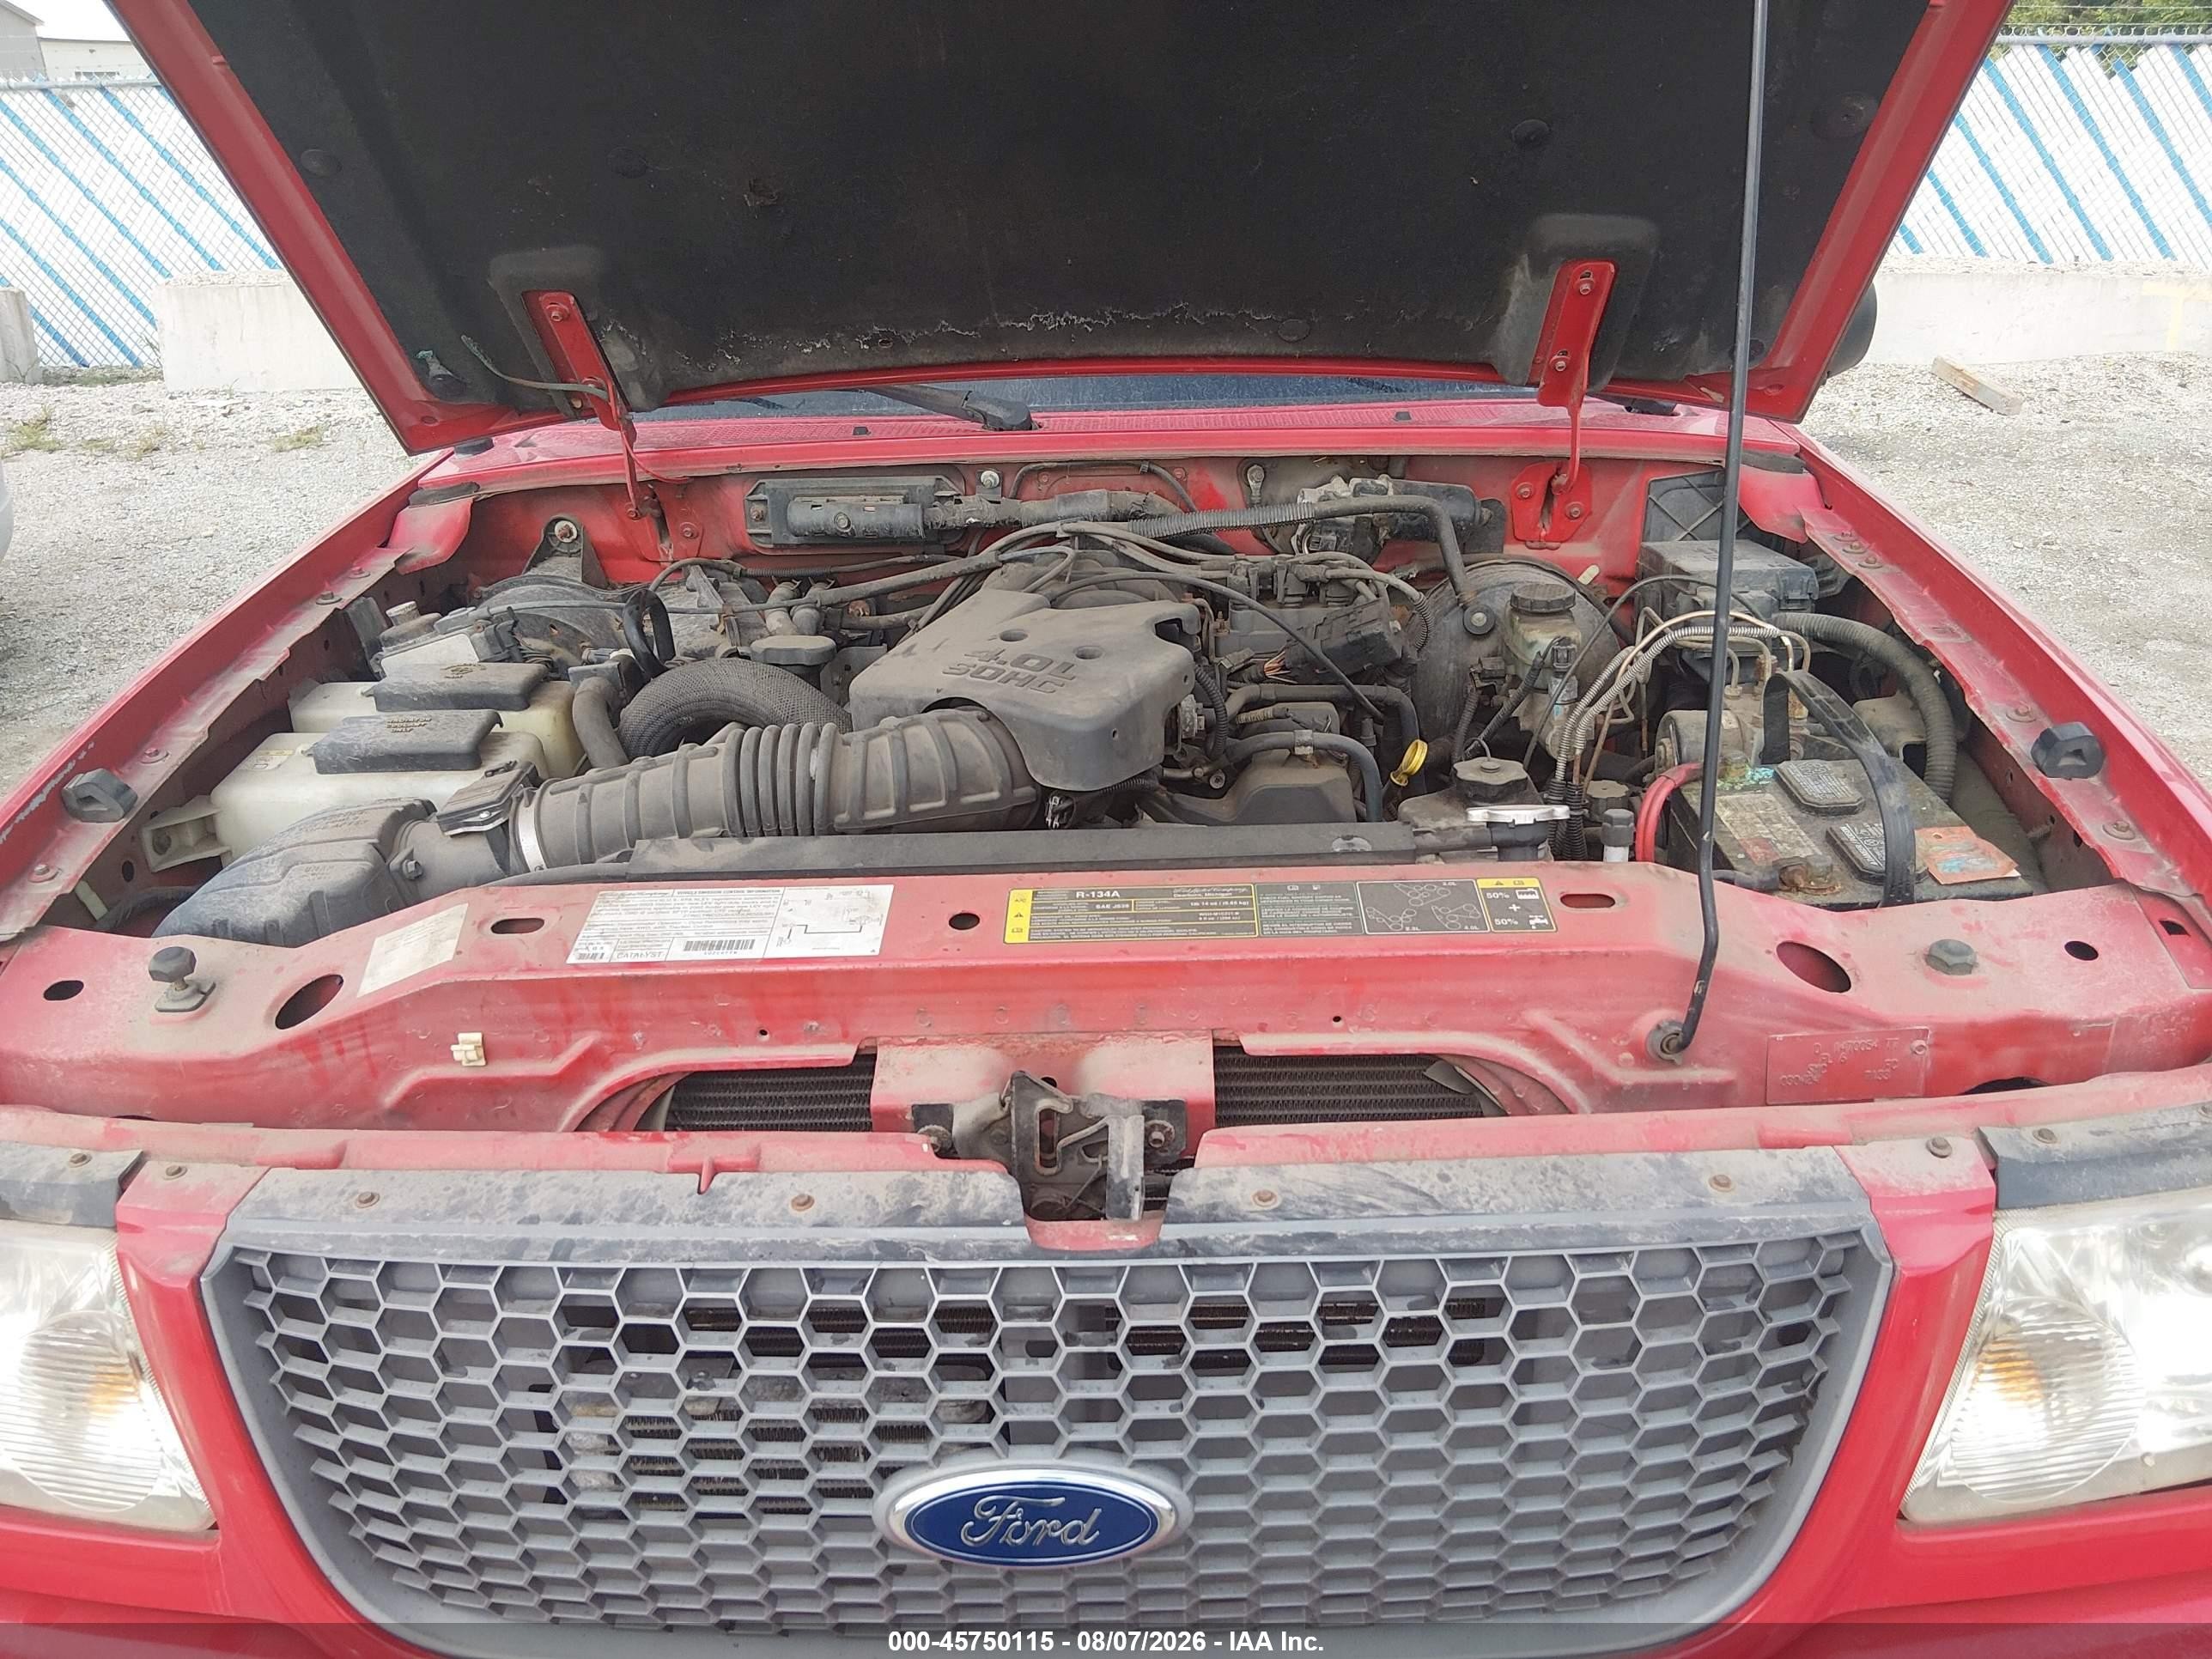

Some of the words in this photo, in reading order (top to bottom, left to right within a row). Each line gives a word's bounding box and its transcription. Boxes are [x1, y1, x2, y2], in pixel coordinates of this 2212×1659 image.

[942, 662, 1066, 694] SOHC
[964, 647, 1078, 682] 4.0L
[1076, 890, 1121, 899] R-134A
[616, 951, 663, 959] CATALYST
[960, 1495, 1103, 1547] Ford
